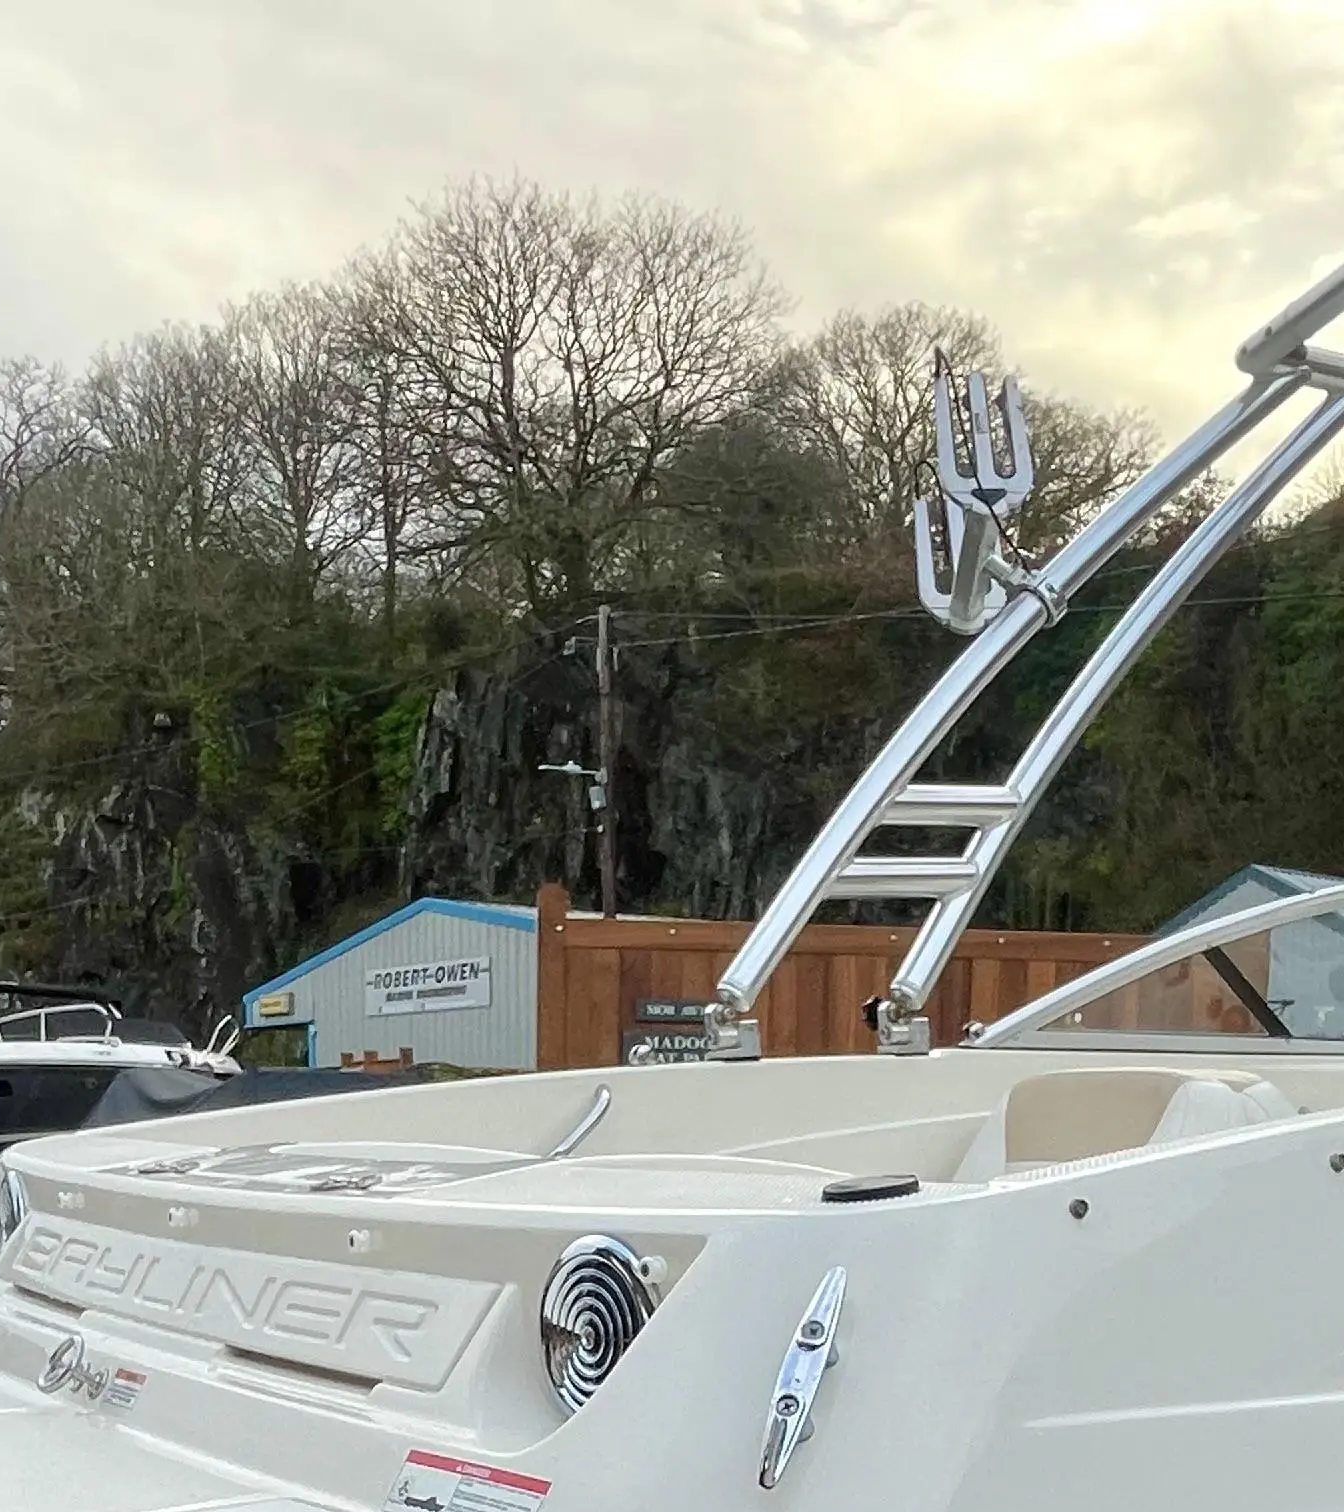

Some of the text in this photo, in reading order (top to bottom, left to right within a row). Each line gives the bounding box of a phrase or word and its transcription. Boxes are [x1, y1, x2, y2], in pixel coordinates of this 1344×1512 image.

[373, 961, 481, 990] ROBERT OWEN
[12, 1225, 440, 1363] BAYLINER
